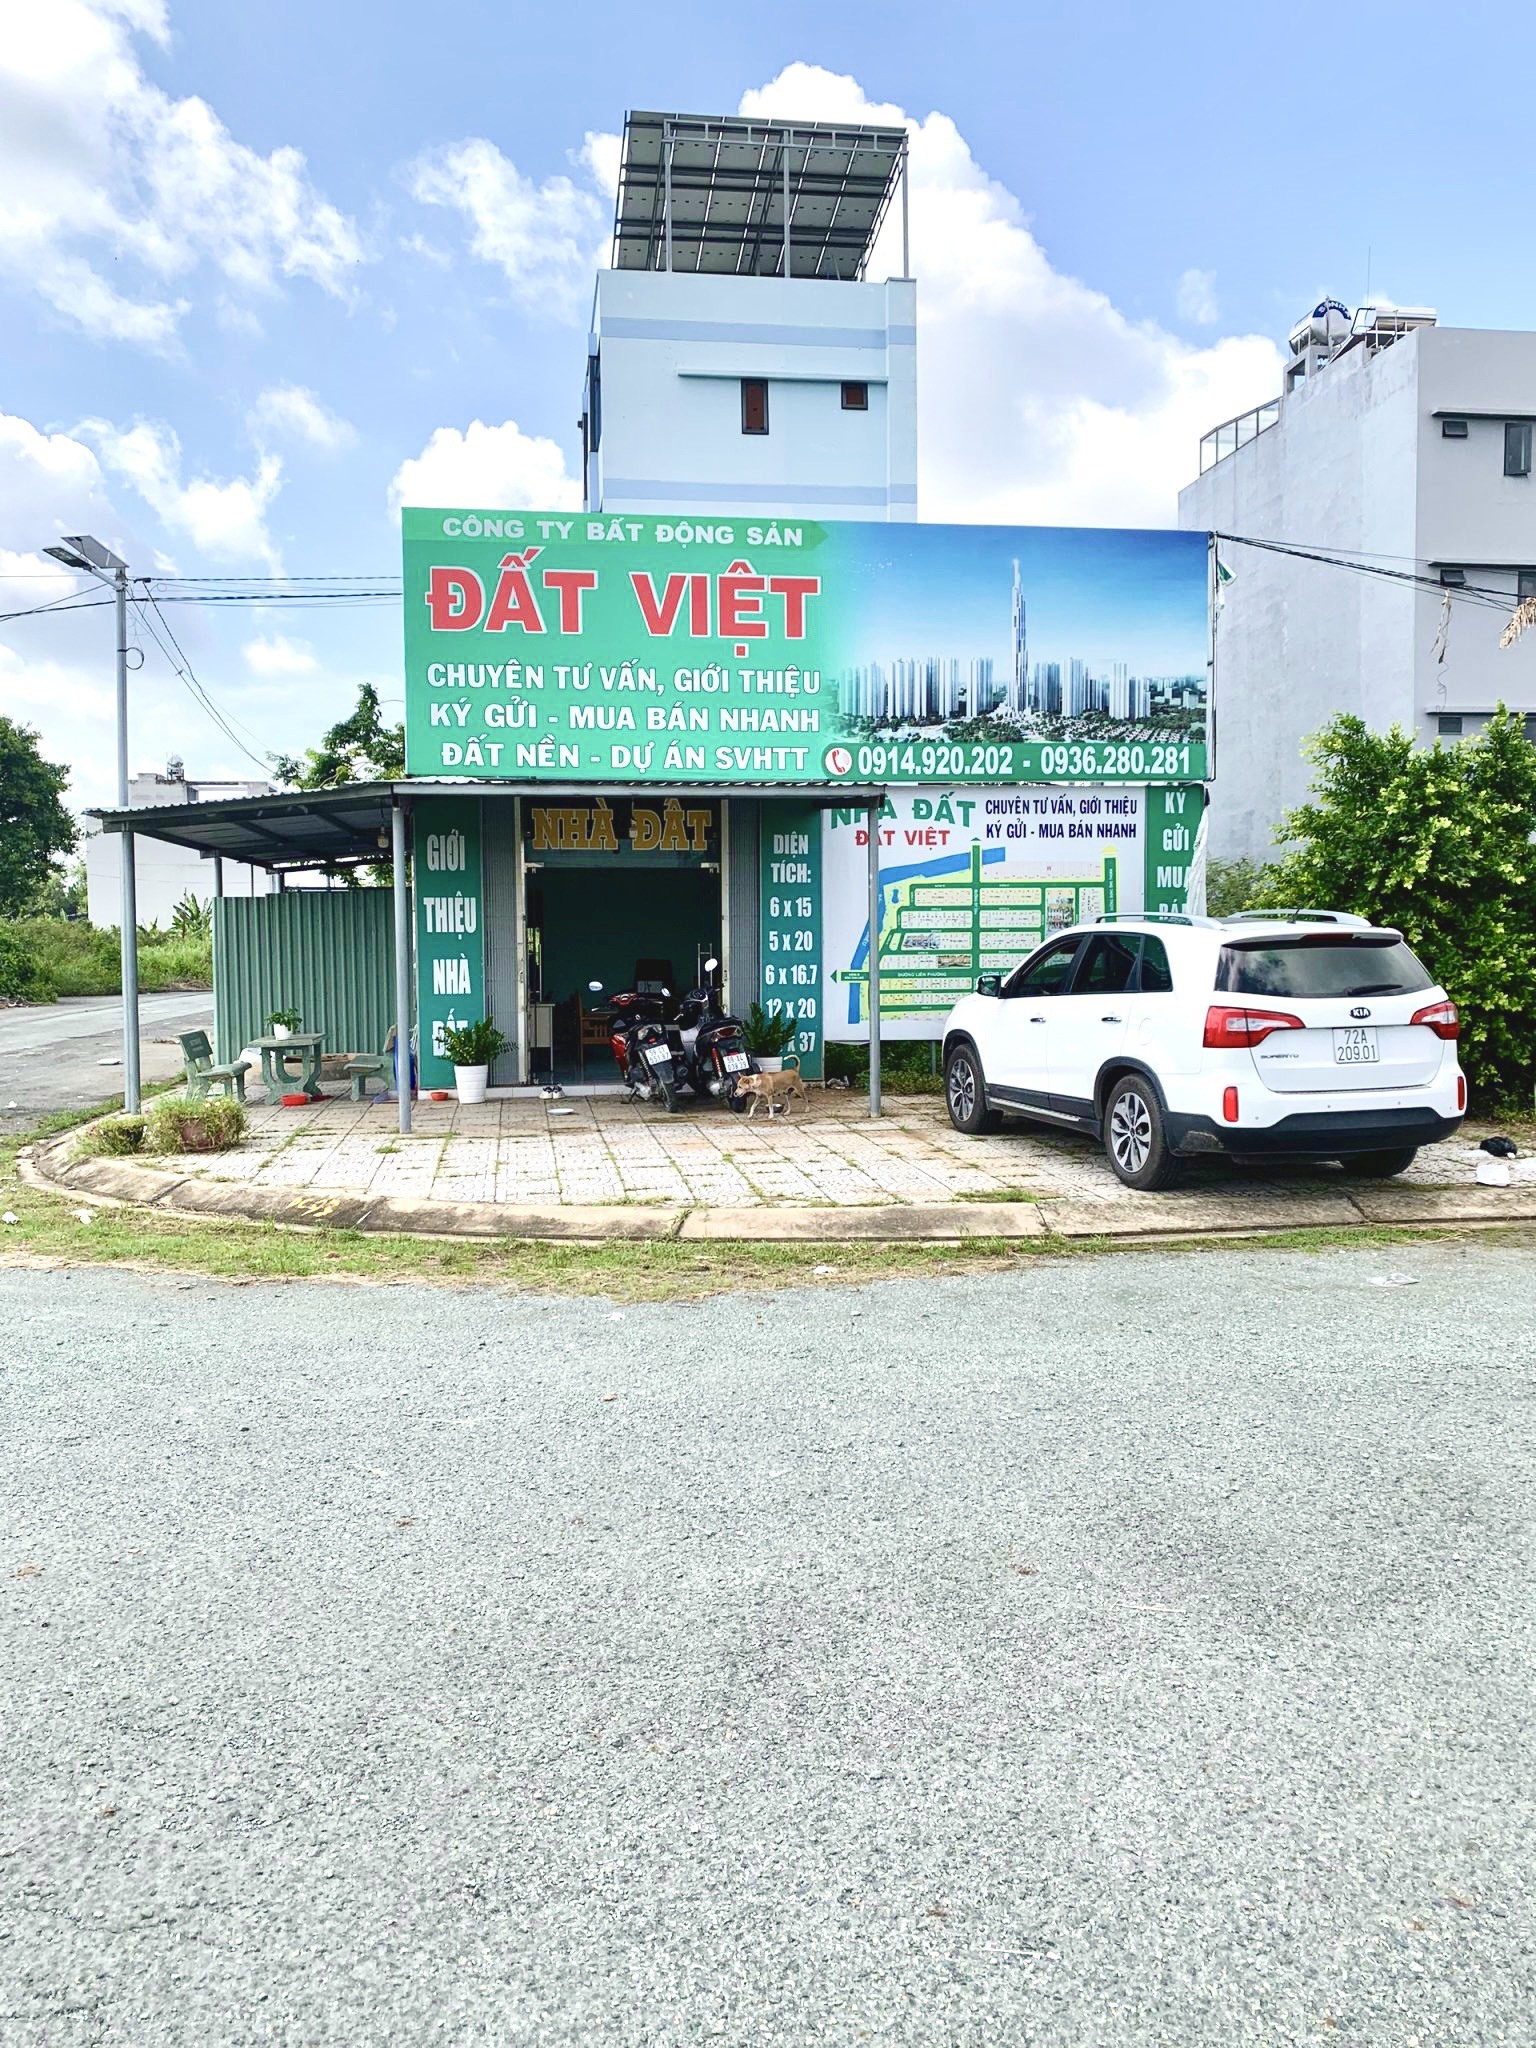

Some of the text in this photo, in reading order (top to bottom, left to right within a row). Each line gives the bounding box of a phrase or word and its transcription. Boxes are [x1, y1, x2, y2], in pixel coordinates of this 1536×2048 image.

[442, 515, 803, 549] CÔNG TY BẤT ĐỘNG SẢN
[425, 546, 822, 658] ĐẤT VIỆT
[426, 658, 821, 699] CHUYÊN TƯ VẤN, GIỚI THIỆU
[430, 697, 473, 727] KÝ
[484, 695, 537, 728] GỬI
[569, 705, 636, 730] MUA
[647, 701, 711, 731] BÁN
[719, 707, 820, 733] NHANH
[441, 734, 504, 766] ĐẤT
[515, 734, 580, 768] NỀN
[611, 741, 655, 773] DỰ
[663, 739, 705, 770] ÁN
[714, 747, 809, 771] SVHTT
[858, 745, 1190, 775] 0914.920.202 - 0936.280.281
[912, 791, 976, 828] ĐẤT
[985, 793, 1137, 817] CHUYÊN TƯ VẤN, GIỚI THIỆU
[1165, 788, 1186, 814] KÝ
[532, 797, 618, 850] NHÀ
[986, 819, 1002, 838] KÝ
[1006, 818, 1027, 839] GỬI
[1038, 823, 1065, 838] MUA
[1068, 819, 1093, 838] BÁN
[1096, 823, 1137, 838] NHANH
[1162, 822, 1189, 851] GỬI
[426, 829, 466, 871] GIỚI
[773, 831, 809, 858] DIỆN
[904, 826, 950, 850] VIỆT
[771, 859, 812, 884] TÍCH:
[423, 891, 477, 940] THIỆU
[770, 896, 812, 917] 6 x 15
[769, 931, 813, 951] 5 x 20
[432, 953, 472, 995] NHÀ
[765, 965, 818, 985] 6 x 16.7
[786, 1001, 795, 1018] x
[798, 998, 816, 1018] 20
[1351, 1008, 1370, 1018] KIA
[799, 1031, 816, 1052] 37
[1344, 1029, 1368, 1044] 72A
[1337, 1045, 1376, 1062] 209.01
